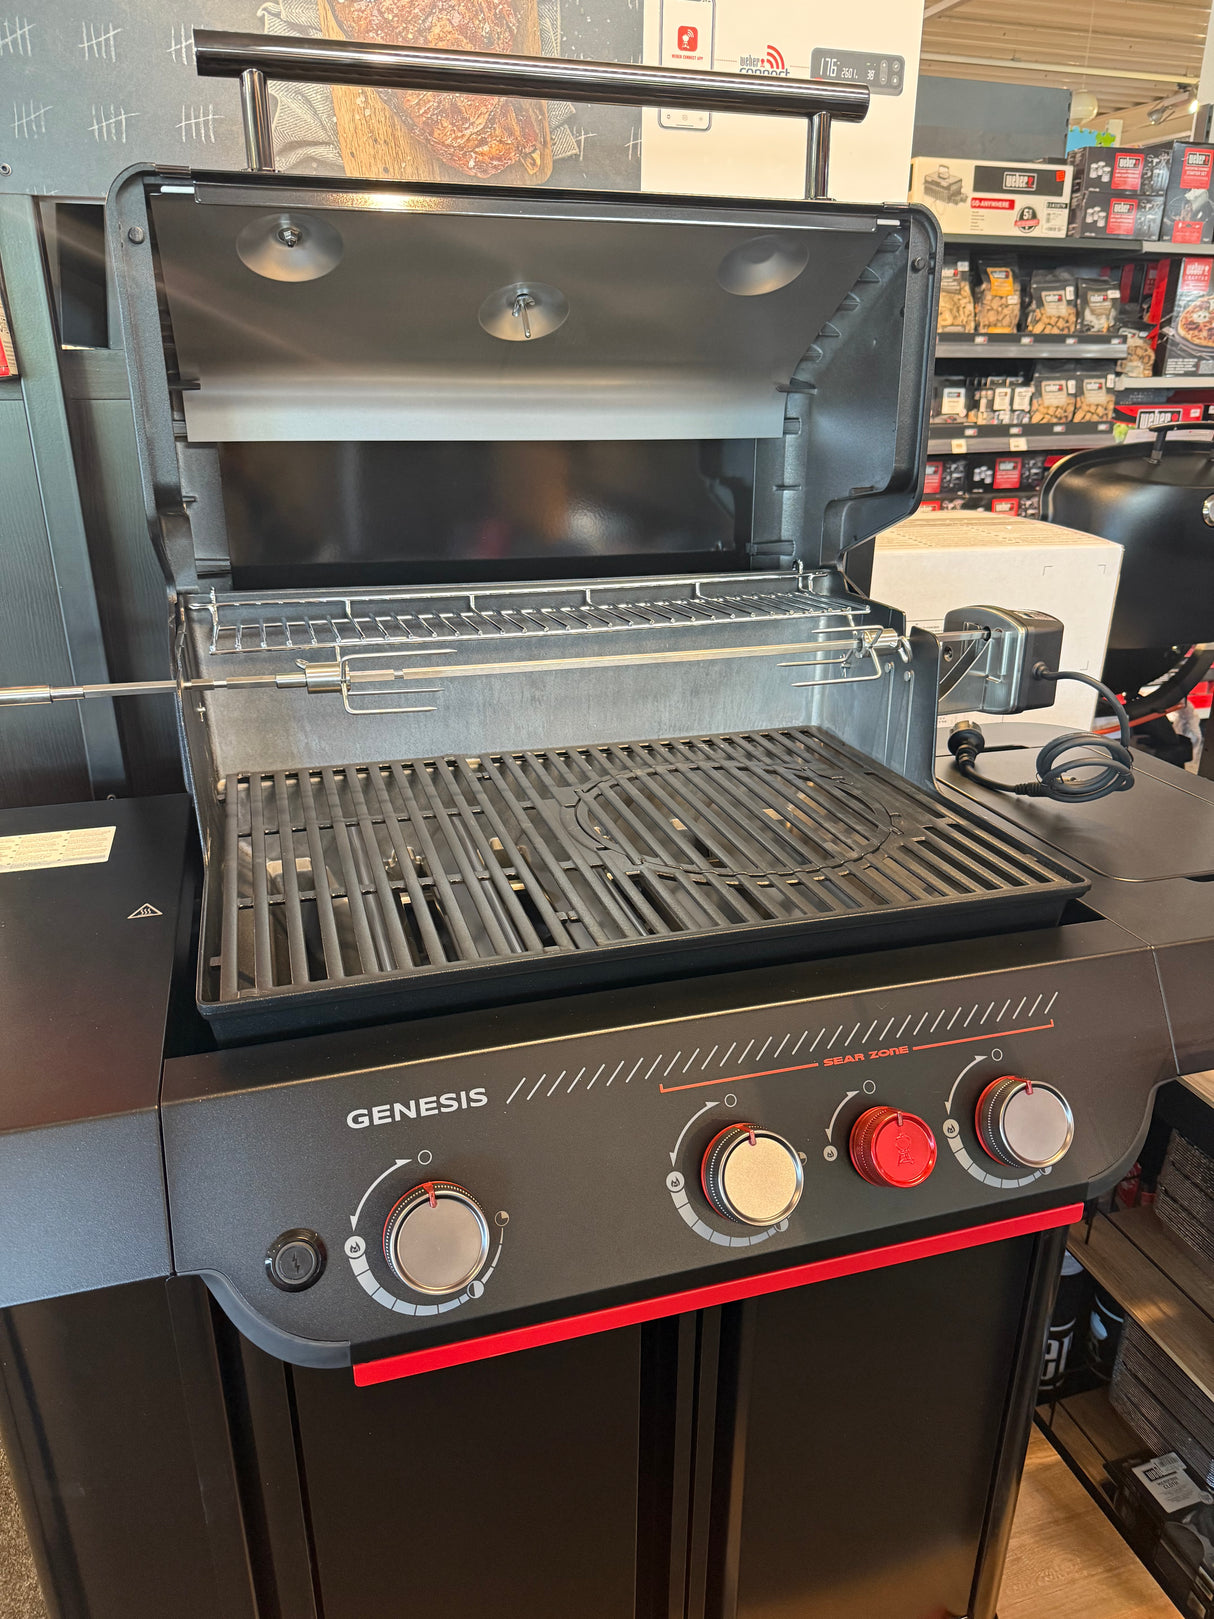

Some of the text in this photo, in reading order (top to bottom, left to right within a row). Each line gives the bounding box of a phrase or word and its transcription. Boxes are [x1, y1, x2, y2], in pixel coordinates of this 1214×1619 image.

[740, 54, 760, 68] weber
[1006, 173, 1028, 188] weber
[972, 200, 1010, 209] GO-ANYWHERE
[1140, 410, 1172, 428] weber
[823, 1046, 909, 1067] SEAR ZONE
[346, 1088, 488, 1129] GENESIS
